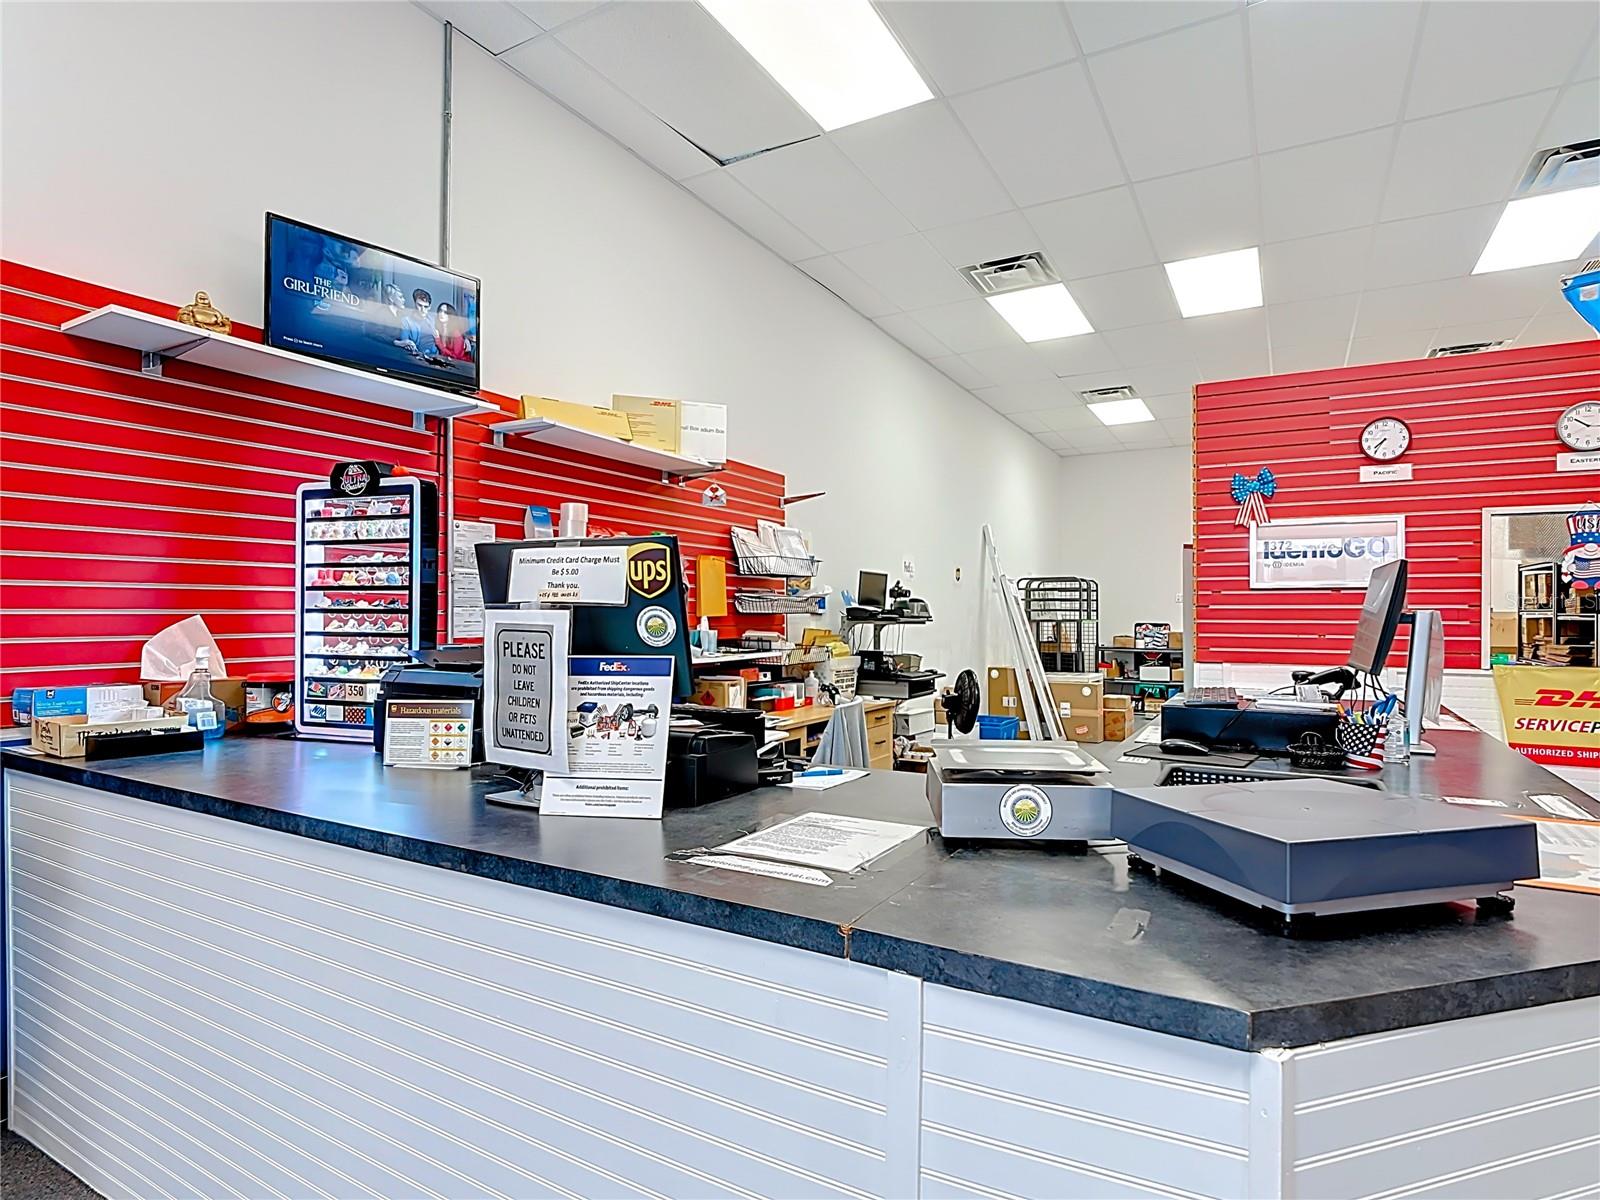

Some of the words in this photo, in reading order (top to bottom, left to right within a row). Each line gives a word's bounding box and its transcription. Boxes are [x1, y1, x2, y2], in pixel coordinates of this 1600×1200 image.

[314, 276, 332, 288] THE
[283, 277, 360, 306] GIRLFRIEND
[580, 556, 601, 565] Charge
[560, 568, 565, 576] $
[629, 560, 667, 590] ups
[547, 581, 565, 589] Thank
[503, 641, 546, 660] PLEASE
[512, 664, 522, 674] DO
[523, 664, 537, 676] NOT
[599, 661, 630, 673] FedEx
[347, 685, 364, 697] 350
[513, 680, 535, 692] LEAVE
[507, 695, 541, 709] CHILDREN
[1534, 688, 1600, 709] DH
[400, 706, 432, 715] Hazardous
[432, 706, 462, 715] materials
[509, 712, 518, 722] OR
[519, 713, 537, 725] PETS
[502, 727, 544, 742] UNATTENDED
[1515, 746, 1574, 758] AUTHORIZED
